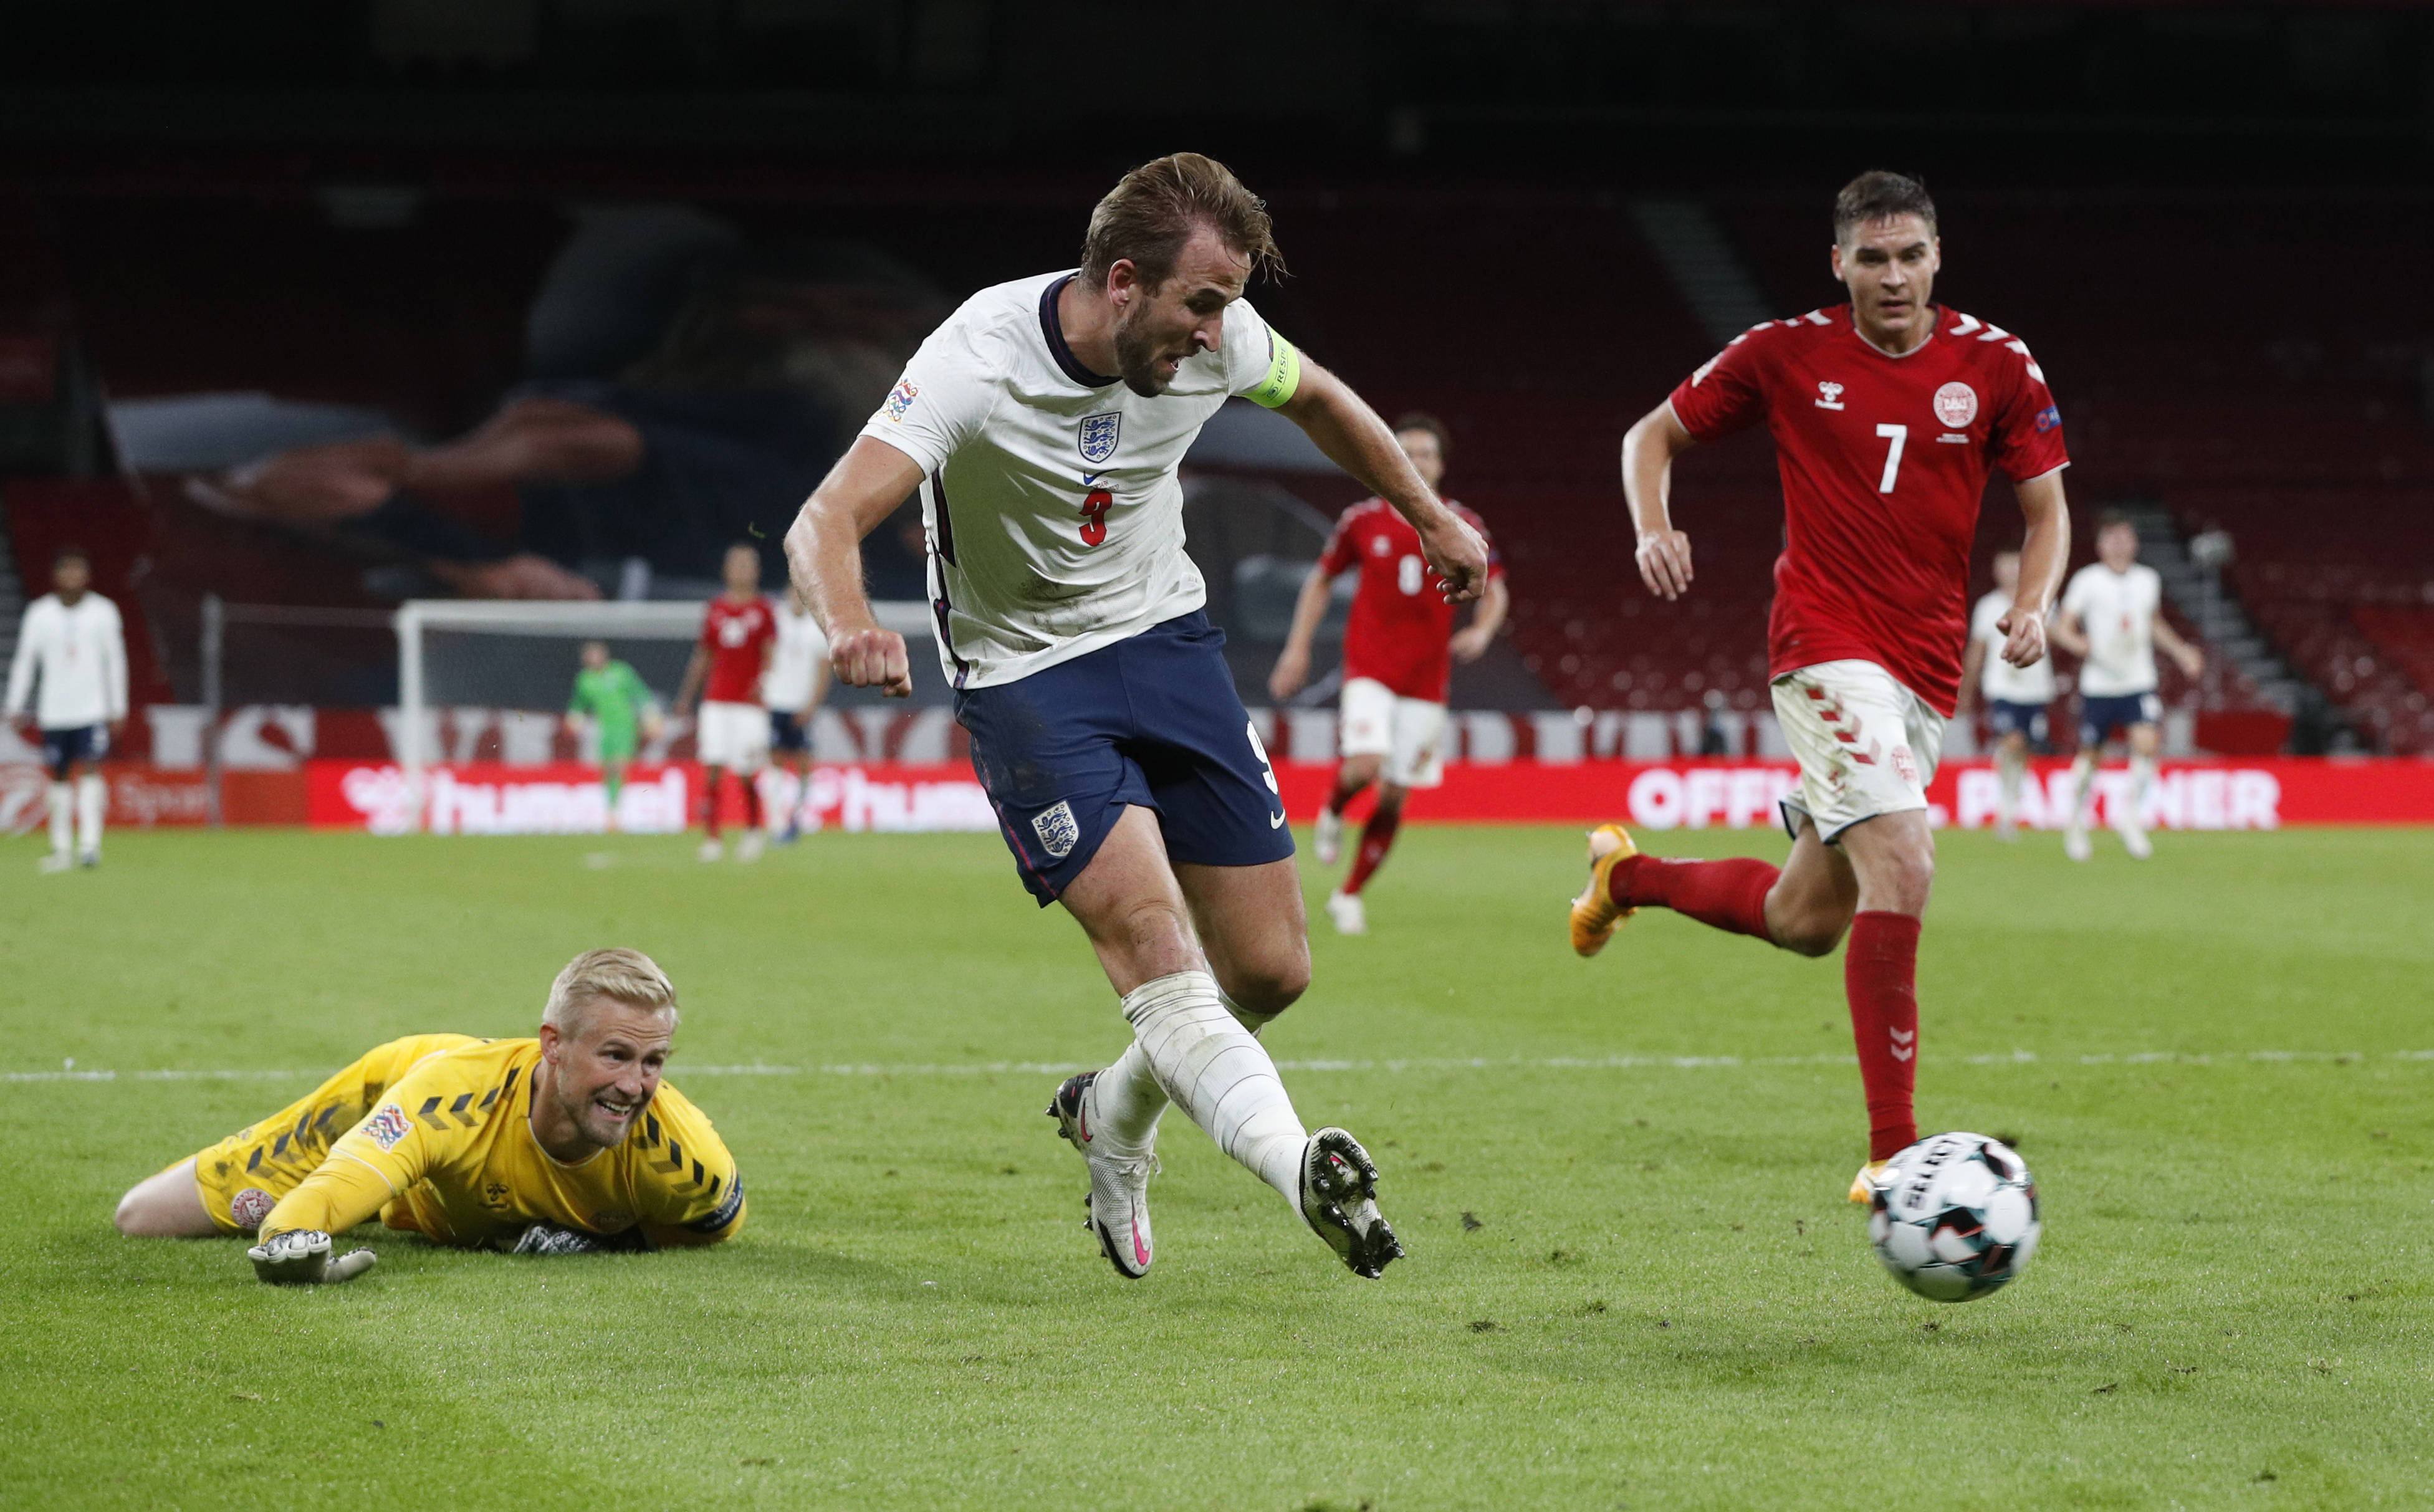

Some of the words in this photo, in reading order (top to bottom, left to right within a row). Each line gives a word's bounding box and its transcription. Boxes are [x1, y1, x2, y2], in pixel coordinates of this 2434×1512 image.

[1876, 423, 1907, 494] 7
[1247, 720, 1278, 795] 9
[841, 767, 1005, 833] hum
[1957, 769, 2281, 831] PARTNER
